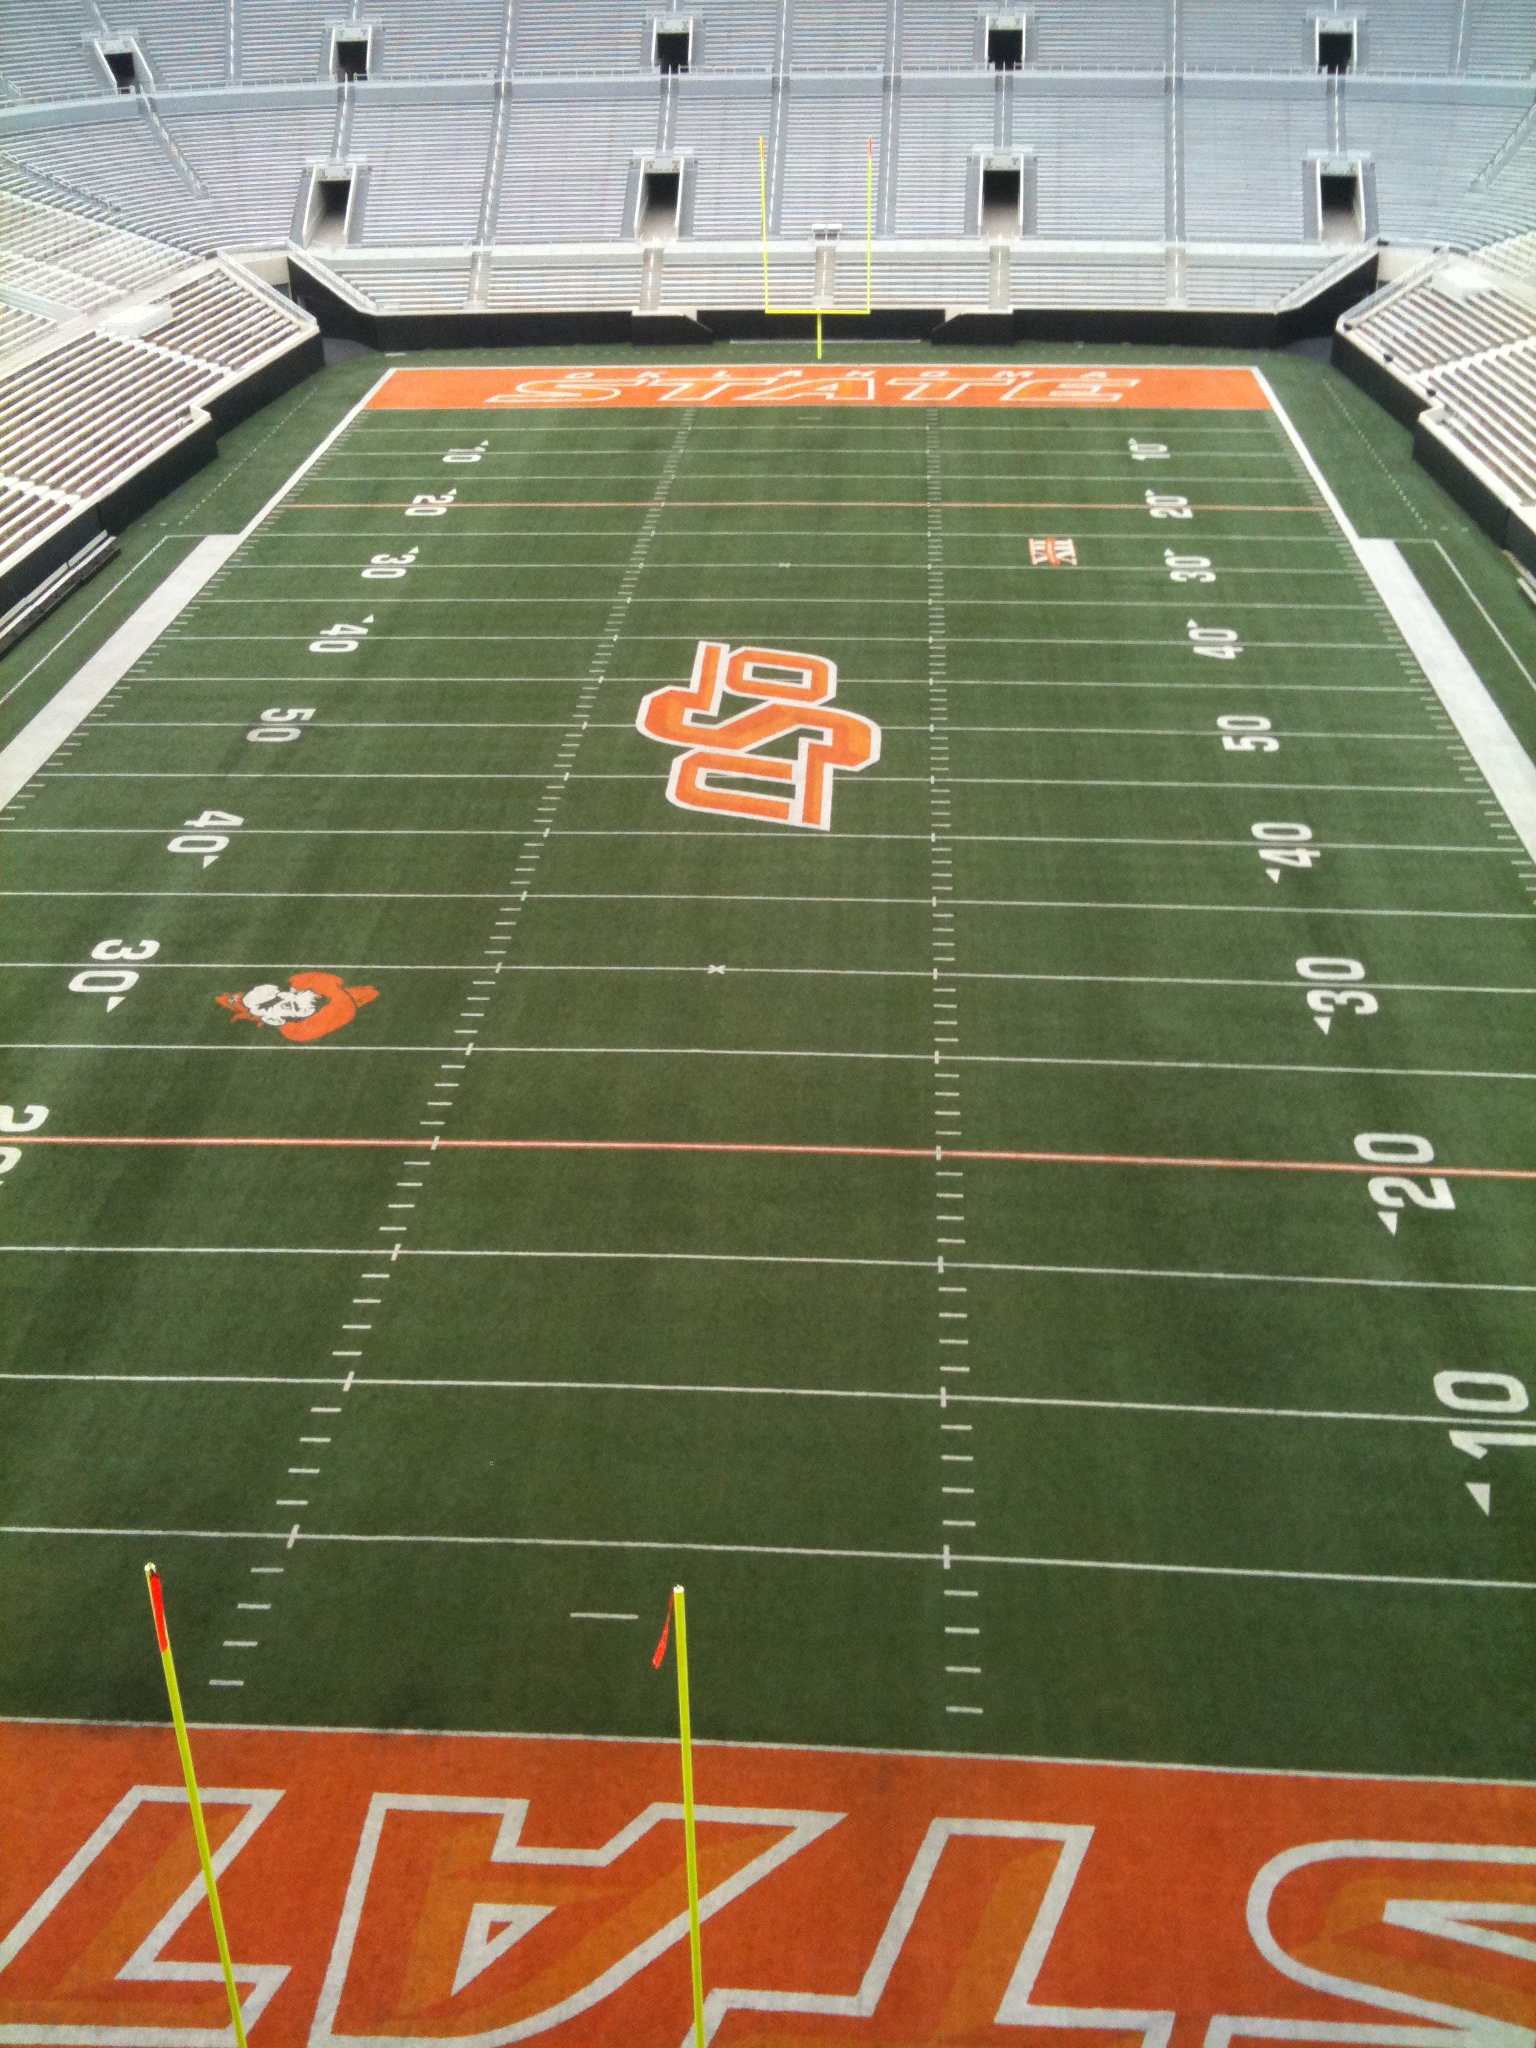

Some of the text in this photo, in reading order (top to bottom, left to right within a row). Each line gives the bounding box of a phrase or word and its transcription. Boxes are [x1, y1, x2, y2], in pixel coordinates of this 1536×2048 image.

[484, 378, 1140, 402] STATE
[442, 446, 486, 463] 10
[1129, 443, 1170, 461] 10
[405, 494, 454, 516] 20
[1146, 495, 1193, 518] 20
[361, 554, 416, 578] 30
[1165, 555, 1216, 582] 30
[309, 623, 369, 653] 40
[1188, 628, 1244, 659] 40
[246, 708, 316, 742] 50
[635, 640, 881, 831] OSU
[1216, 715, 1280, 752] 50
[167, 811, 245, 854] 40
[1251, 822, 1321, 868] 40
[68, 939, 160, 993] 30
[1295, 957, 1378, 1015] 30
[0, 1105, 49, 1174] 2
[1353, 1132, 1456, 1210] 20
[1432, 1370, 1536, 1460] 10
